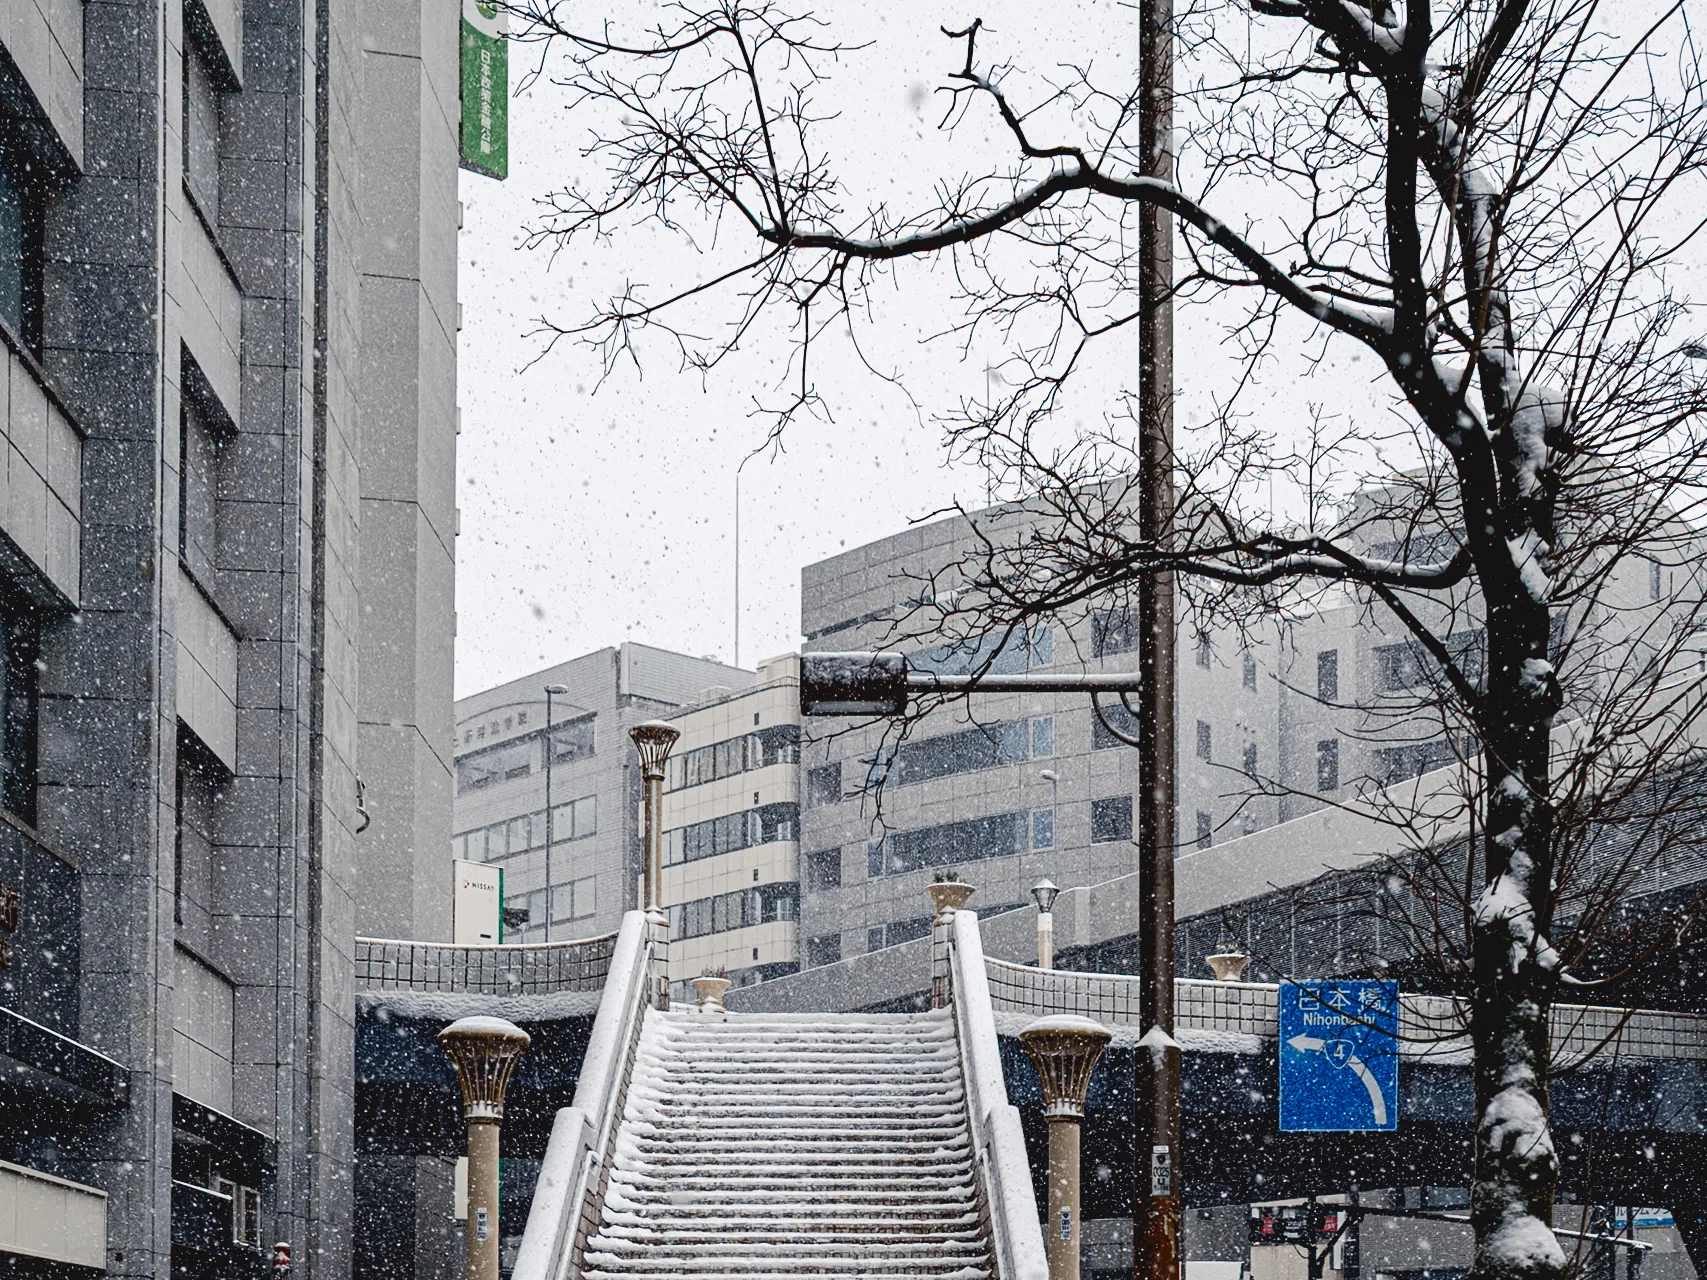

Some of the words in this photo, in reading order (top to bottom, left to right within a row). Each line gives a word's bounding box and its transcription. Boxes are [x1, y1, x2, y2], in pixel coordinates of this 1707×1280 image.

[471, 882, 494, 891] NISSAY
[1298, 987, 1382, 1012] 日本橋
[1303, 1012, 1376, 1026] Nihonbashi
[1333, 1044, 1345, 1060] 4
